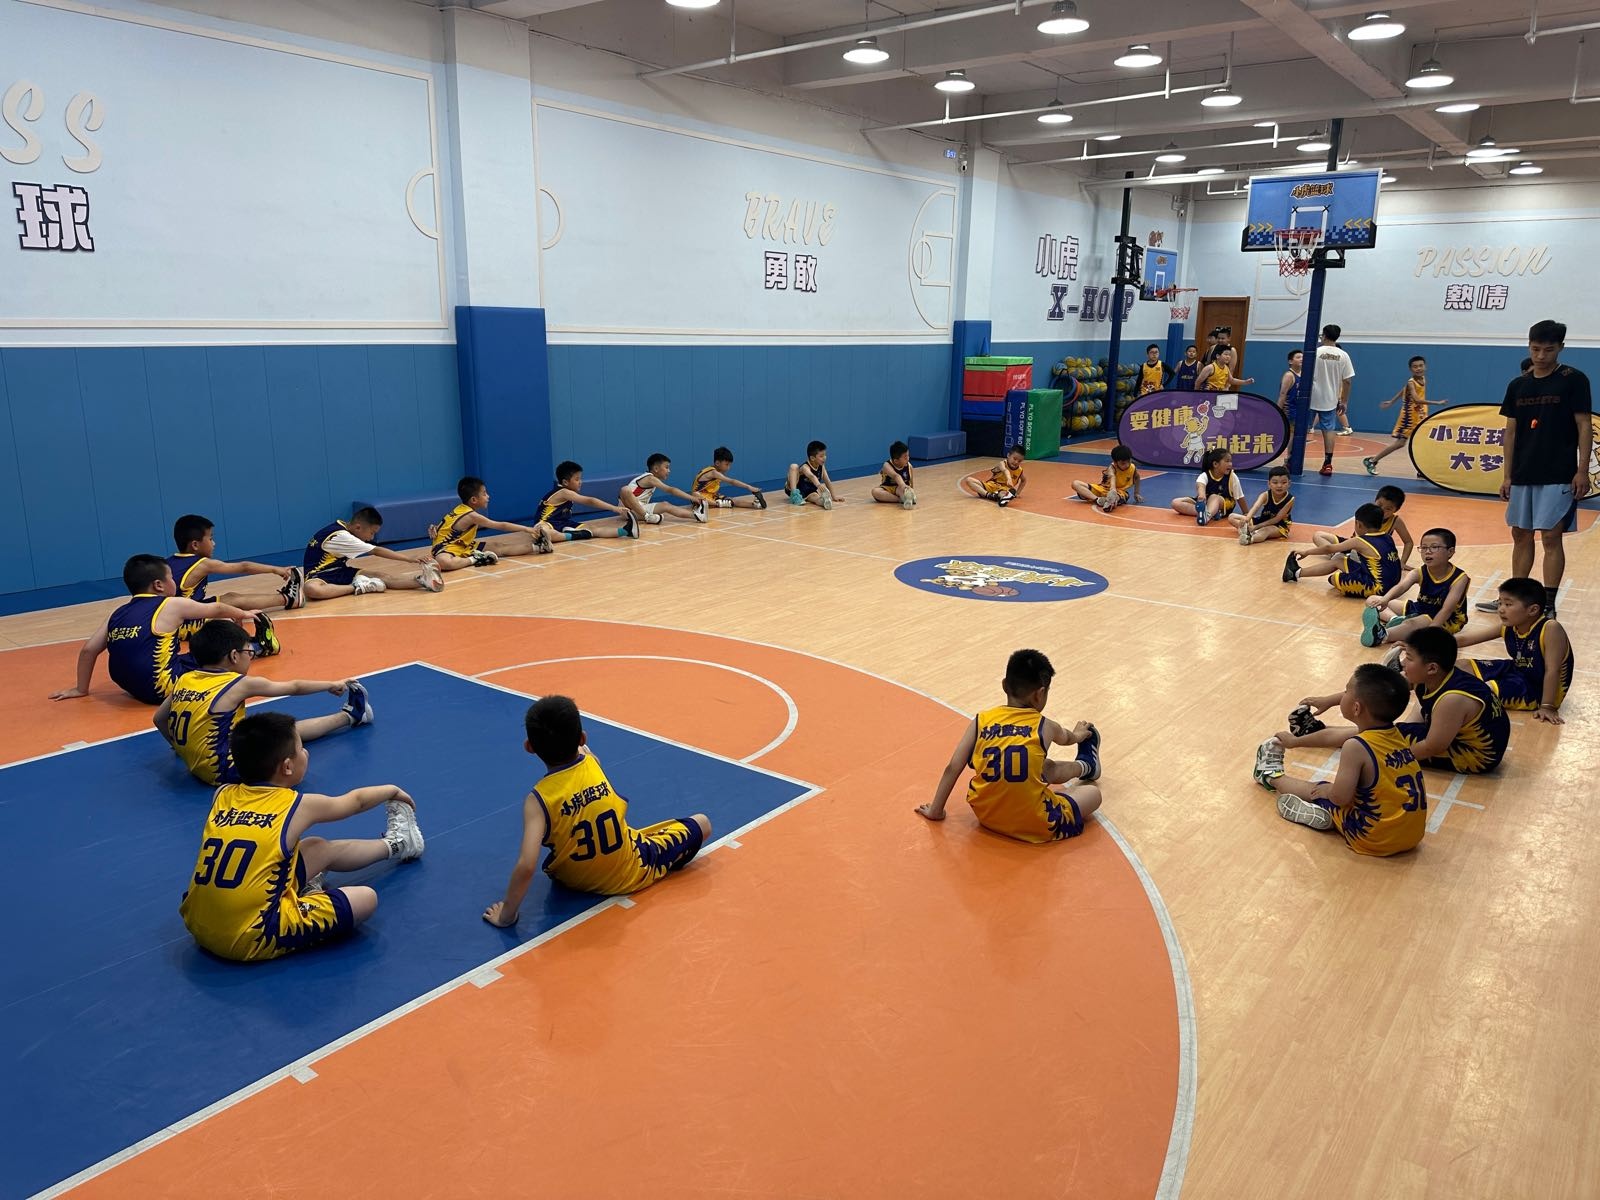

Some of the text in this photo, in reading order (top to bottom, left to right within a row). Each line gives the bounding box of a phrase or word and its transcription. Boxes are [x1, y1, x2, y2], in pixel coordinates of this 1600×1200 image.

[12, 181, 95, 252] 球
[743, 191, 838, 247] BRAVE
[764, 250, 818, 293] 勇敢
[1413, 244, 1553, 278] PASSION
[1047, 284, 1136, 322] X-HOP
[1443, 284, 1509, 311] 熱情
[1450, 452, 1504, 472] 大梦
[980, 744, 1029, 783] 30
[569, 808, 624, 862] 30
[194, 837, 258, 890] 30
